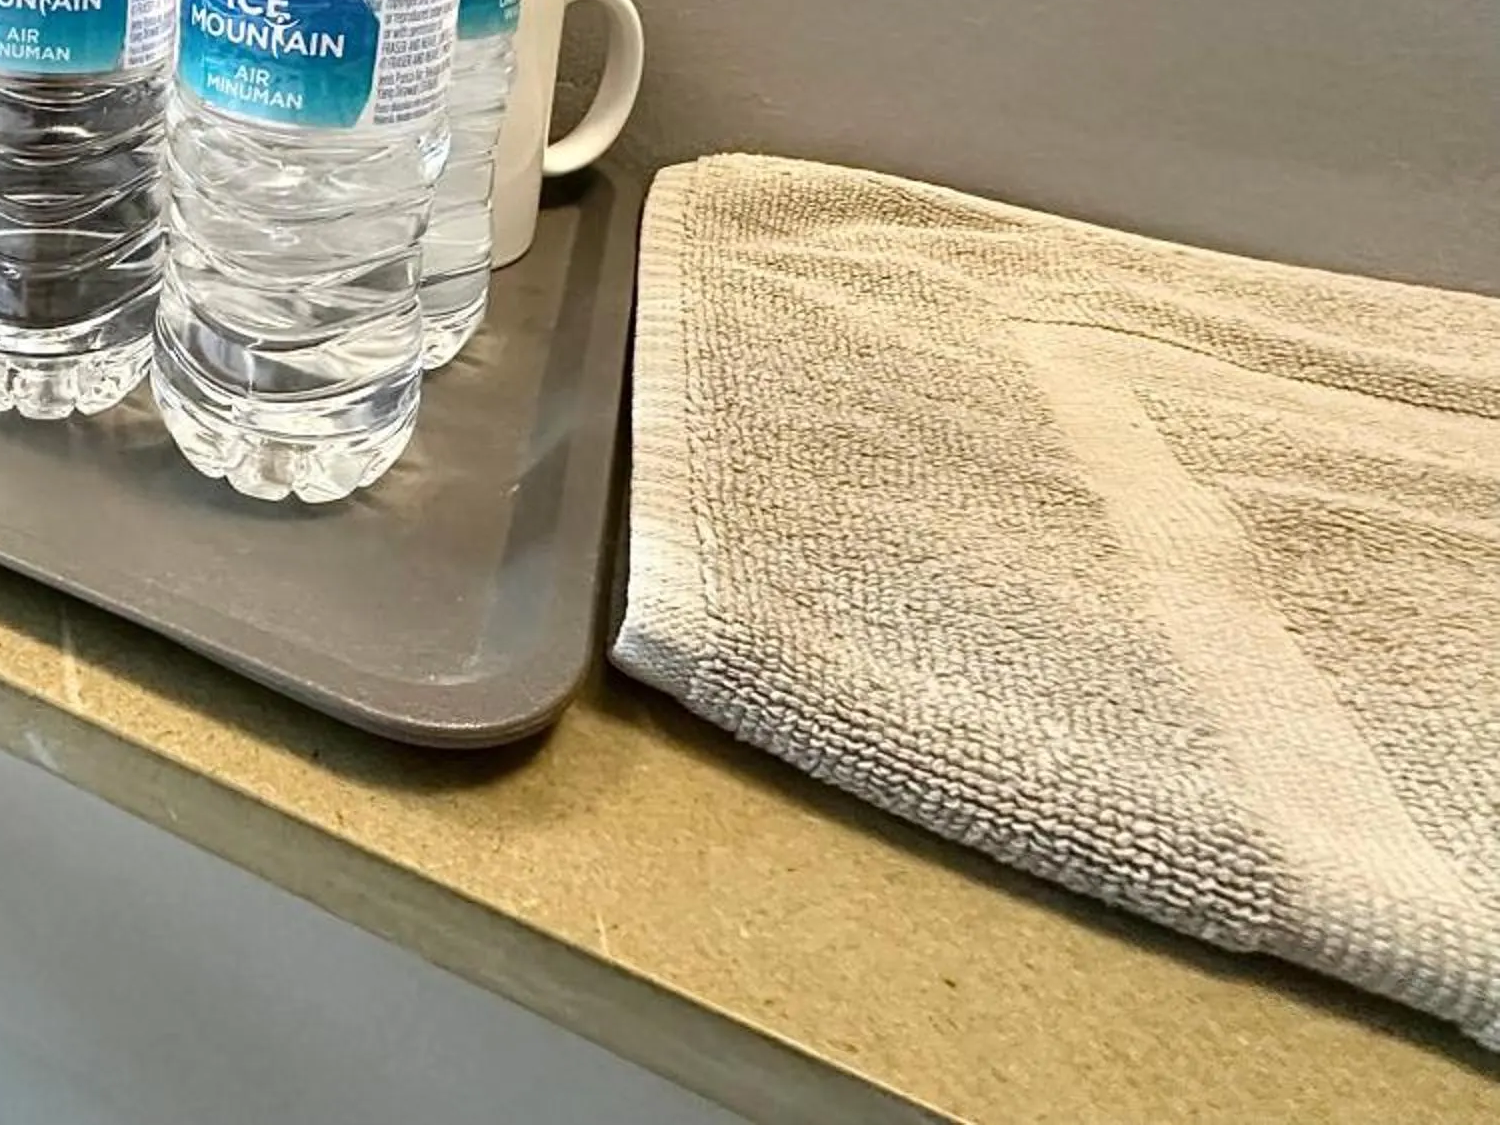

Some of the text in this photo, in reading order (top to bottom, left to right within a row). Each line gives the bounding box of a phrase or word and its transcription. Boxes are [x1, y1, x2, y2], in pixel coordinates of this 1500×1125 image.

[7, 27, 40, 44] AIR
[191, 3, 346, 59] MOUNTAIN
[234, 65, 271, 86] AIR
[207, 72, 304, 110] MINUMAN
